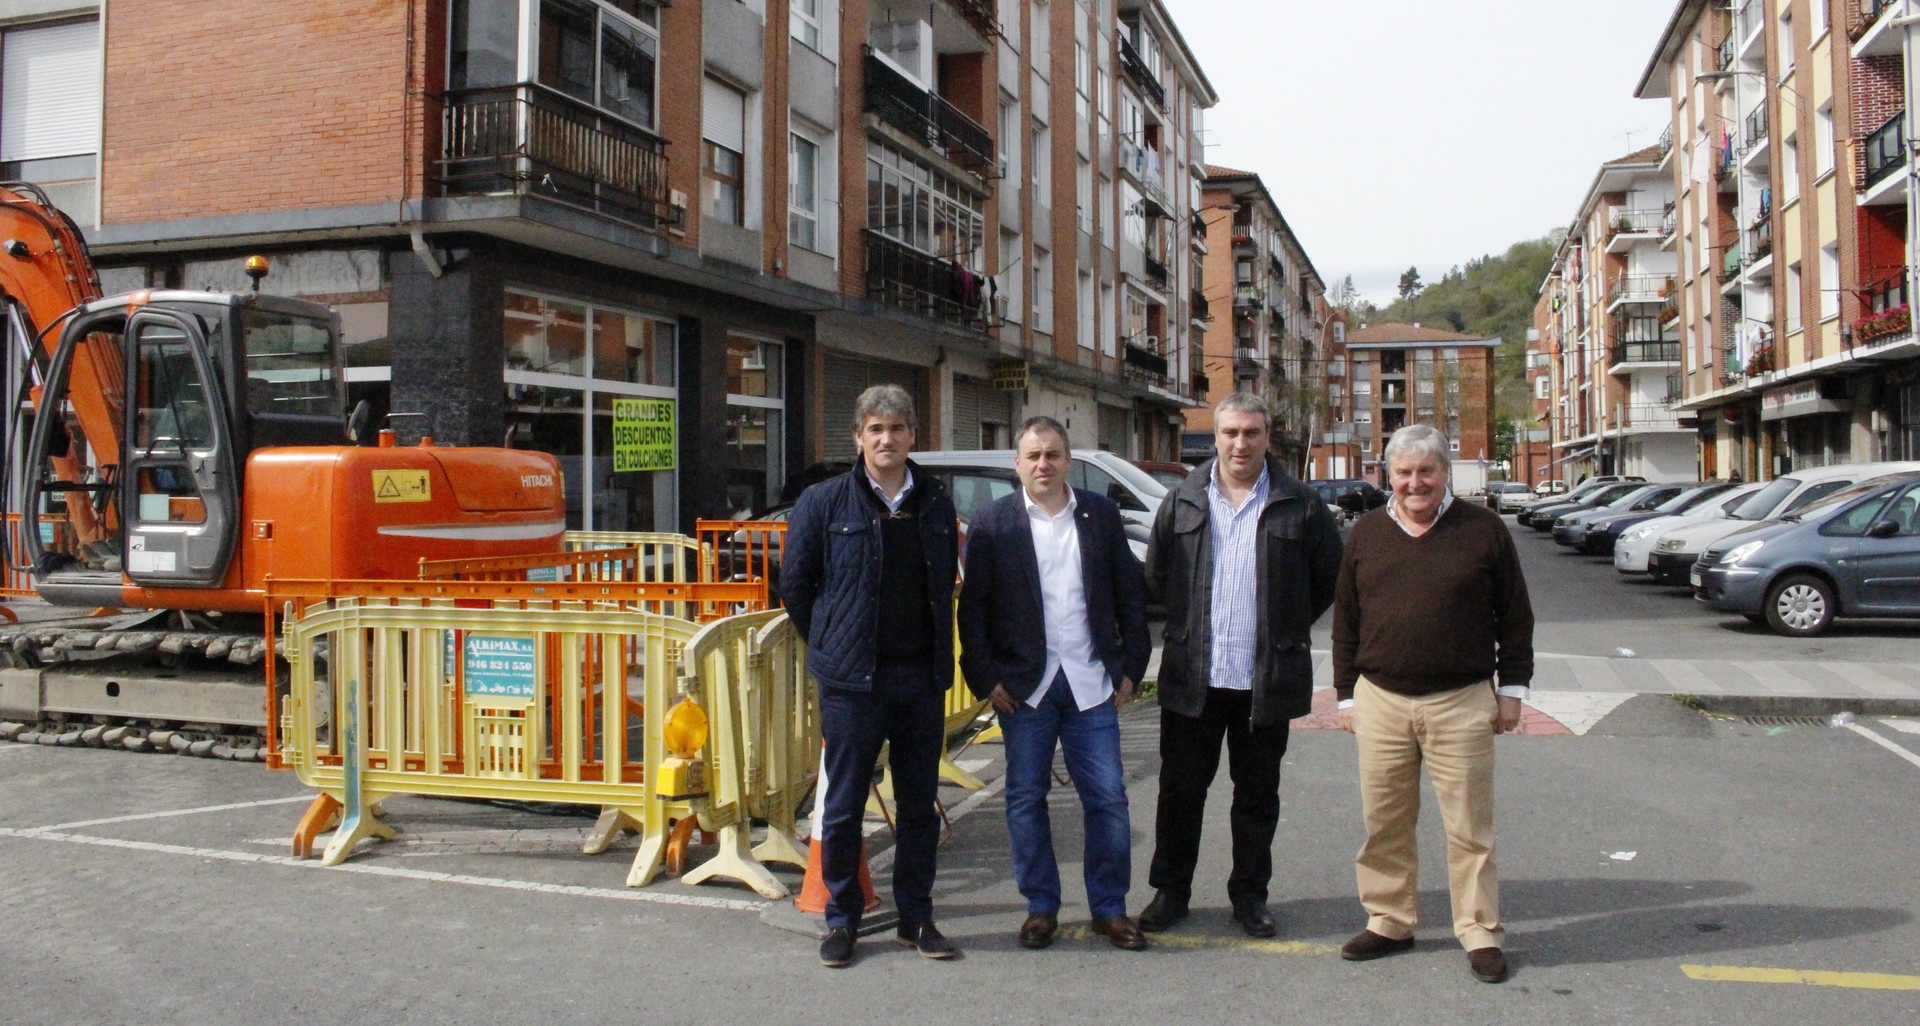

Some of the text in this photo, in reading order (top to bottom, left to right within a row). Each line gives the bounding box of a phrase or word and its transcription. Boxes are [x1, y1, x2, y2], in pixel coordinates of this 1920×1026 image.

[996, 379, 1025, 389] BAR
[616, 403, 671, 422] GRANDES
[615, 427, 672, 446] DESCUENTOS
[616, 449, 673, 469] EN COLCHONES
[521, 474, 553, 487] HITACHI
[467, 660, 532, 671] 946 824 550
